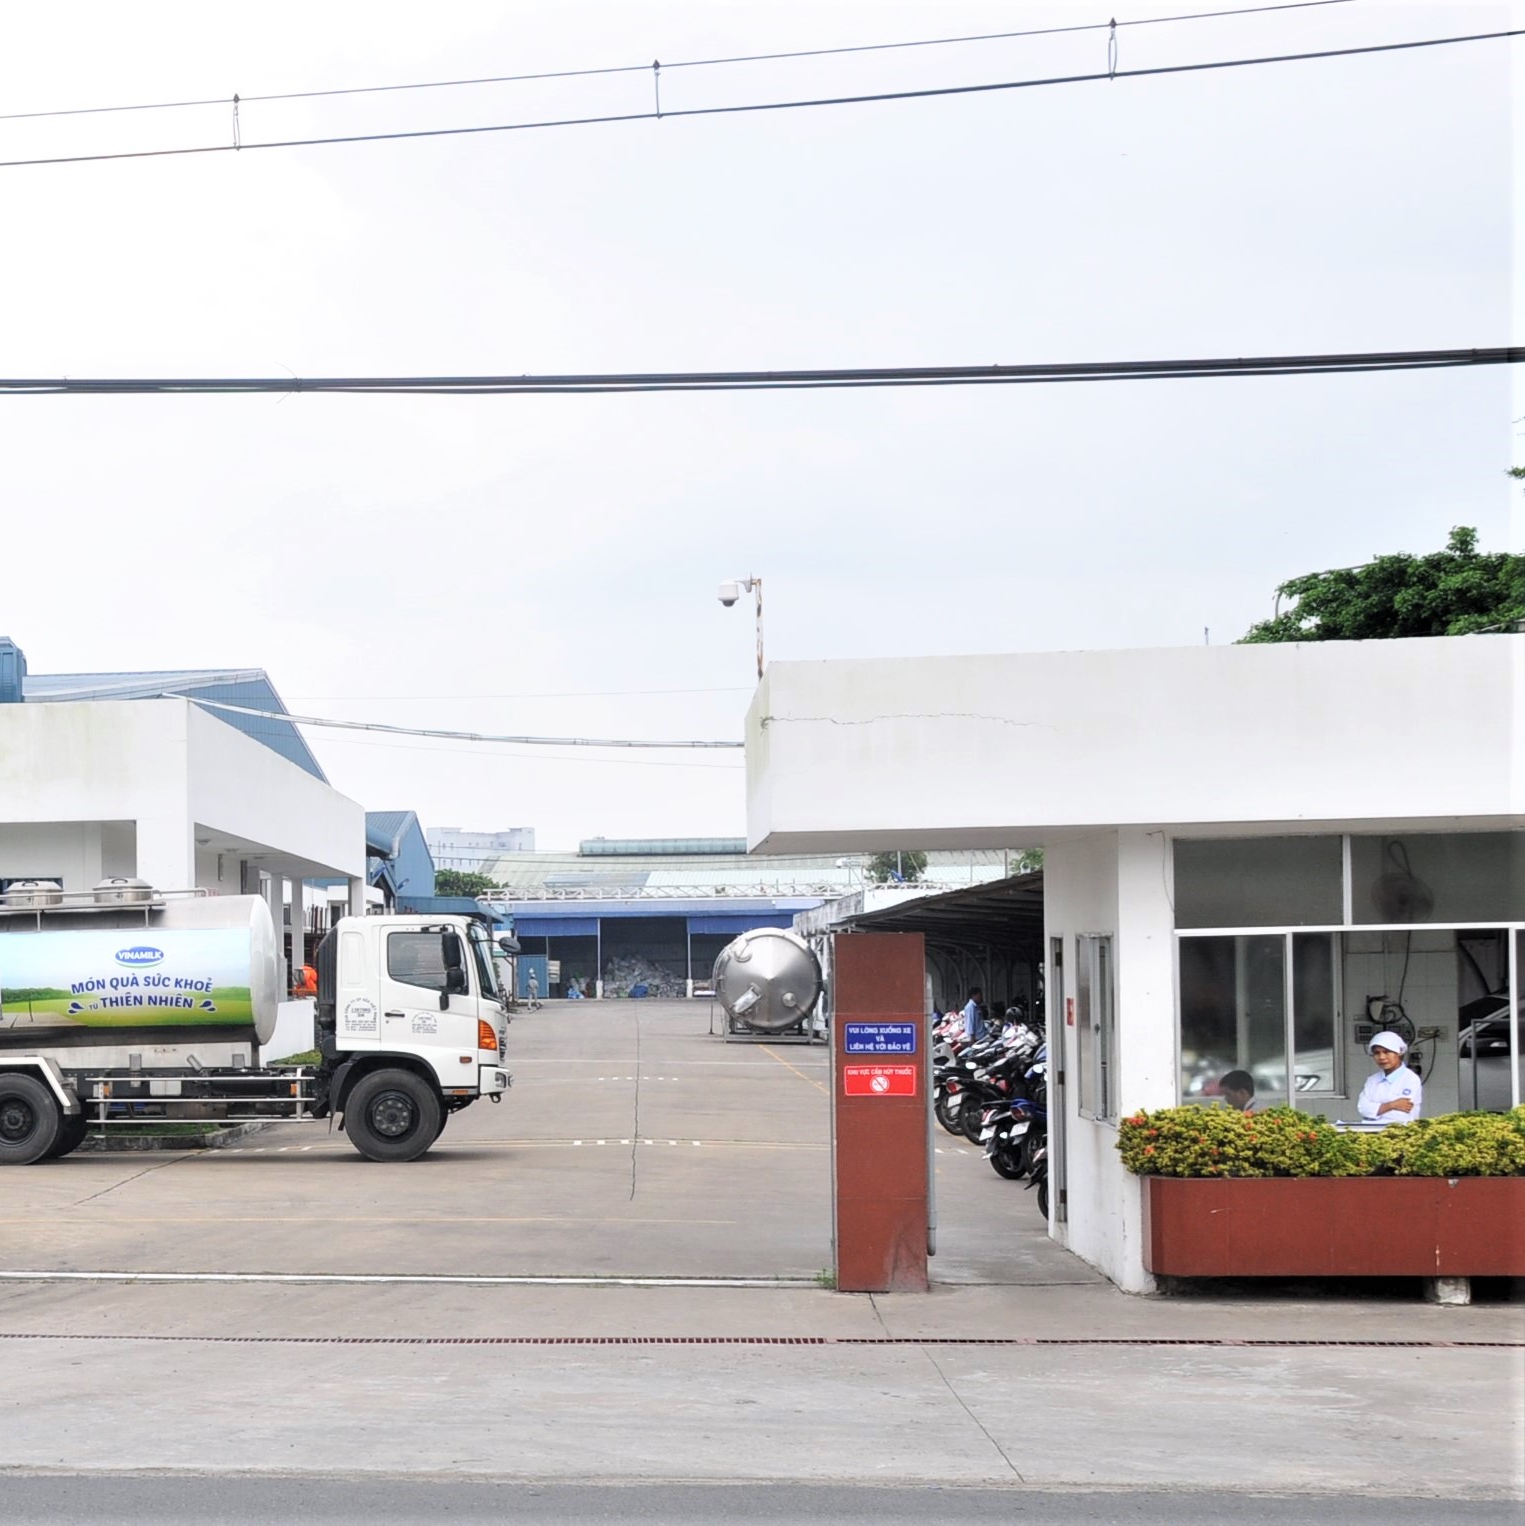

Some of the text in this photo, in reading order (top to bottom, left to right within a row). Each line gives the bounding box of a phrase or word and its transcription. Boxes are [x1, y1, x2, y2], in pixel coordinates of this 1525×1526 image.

[118, 951, 162, 960] VINAMILK
[71, 972, 213, 995] MÓN QUÀ SỨC KHOẺ
[100, 991, 143, 1008] THIÊN
[147, 993, 194, 1009] NHIÊN
[861, 1026, 878, 1034] LÒNG
